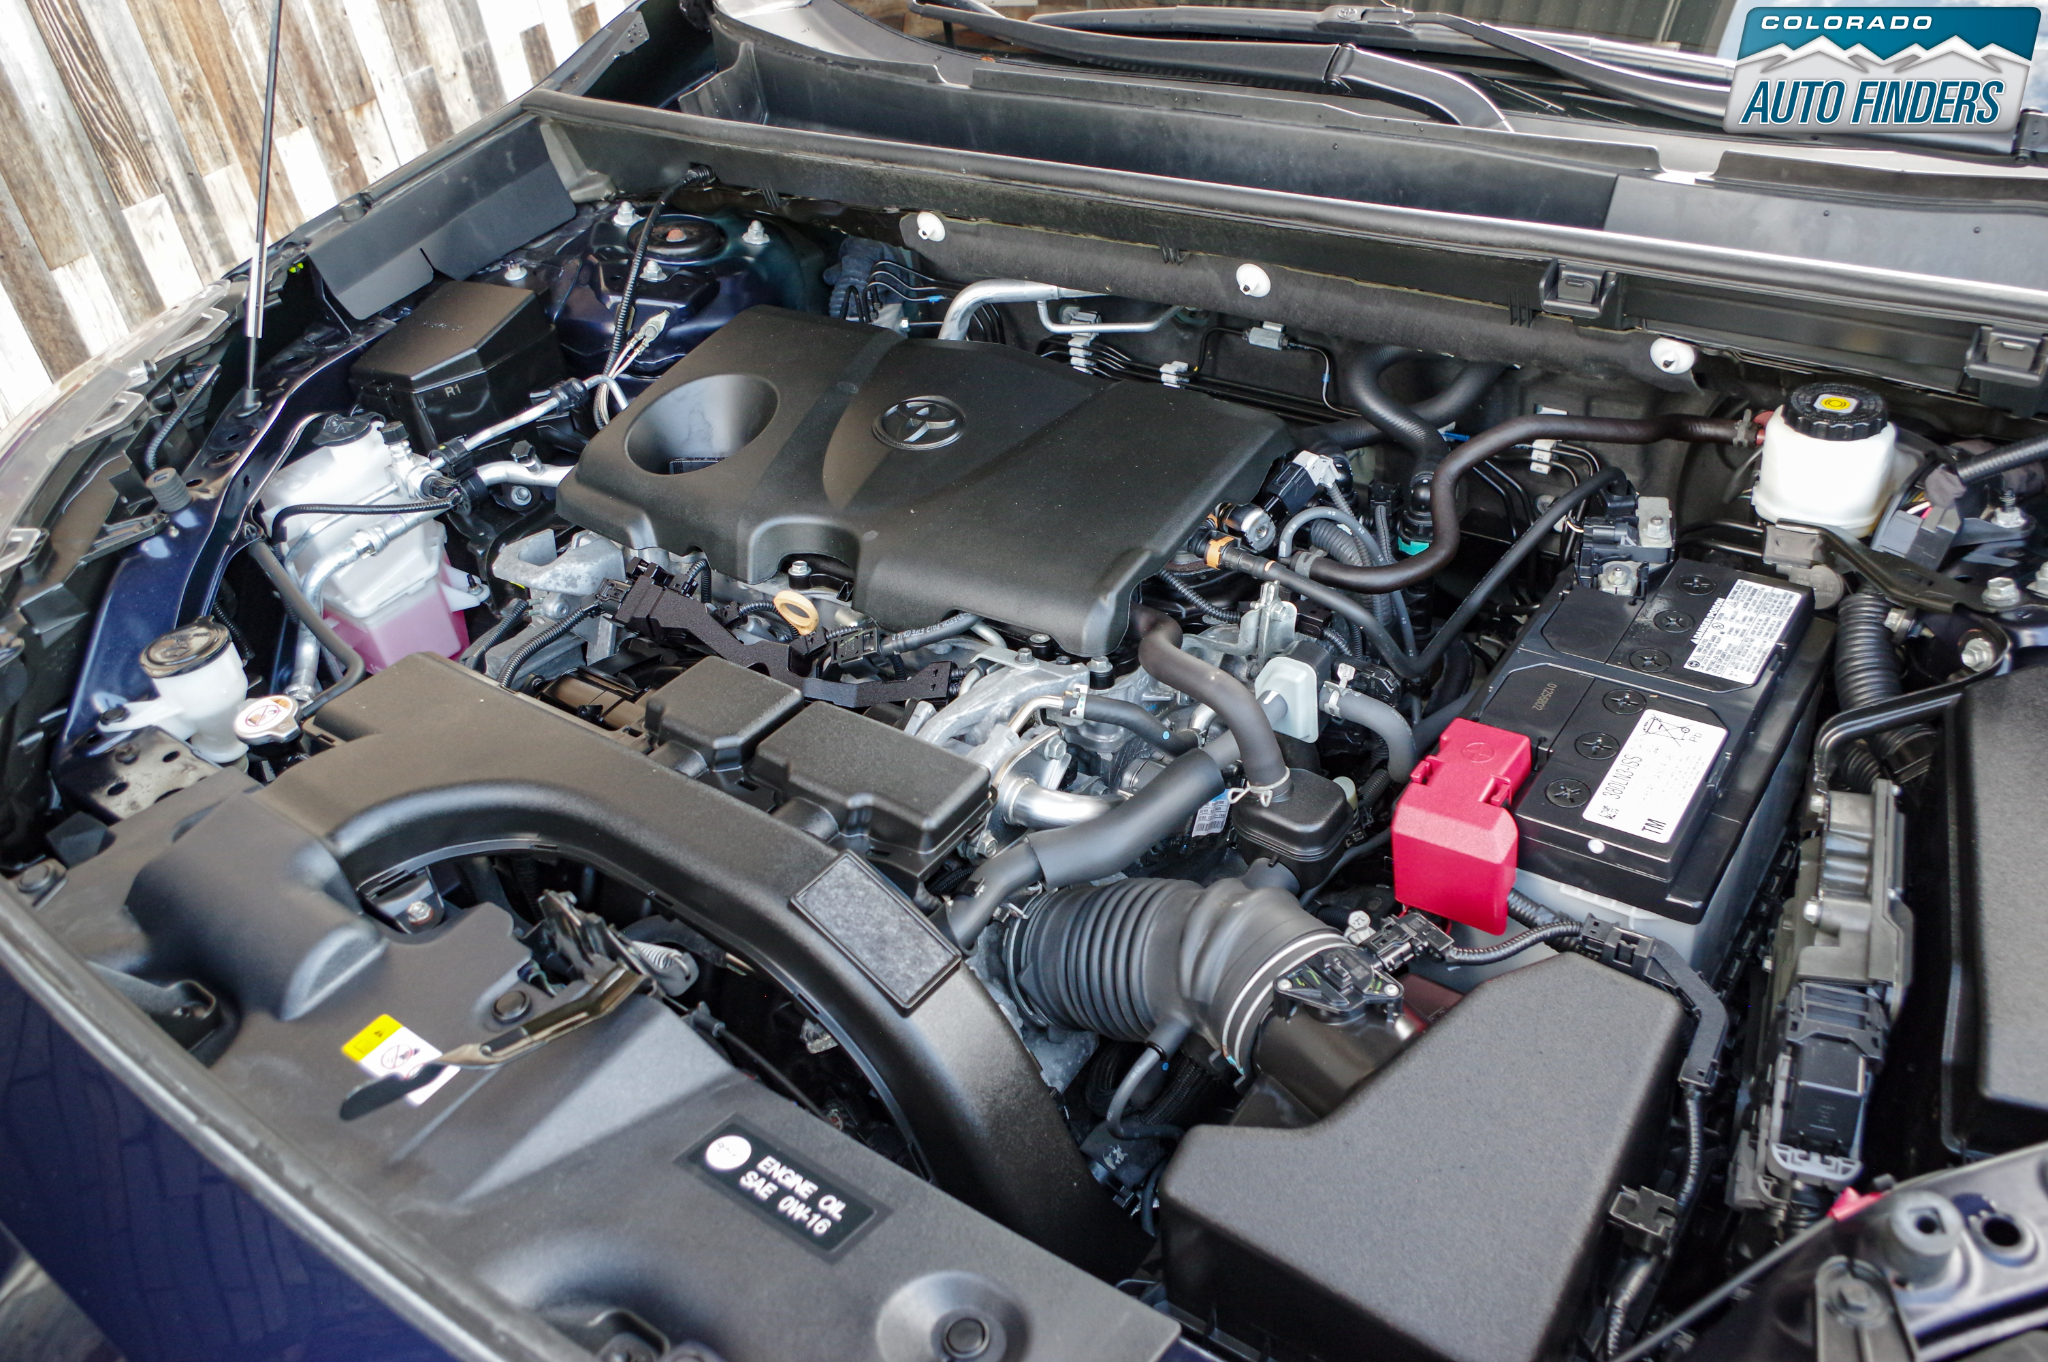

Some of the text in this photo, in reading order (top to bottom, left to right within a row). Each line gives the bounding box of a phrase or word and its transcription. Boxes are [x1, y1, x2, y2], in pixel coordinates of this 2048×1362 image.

[445, 384, 461, 397] R1
[739, 1171, 832, 1235] SAE 0W-16
[757, 1156, 846, 1221] ENGINE OIL
